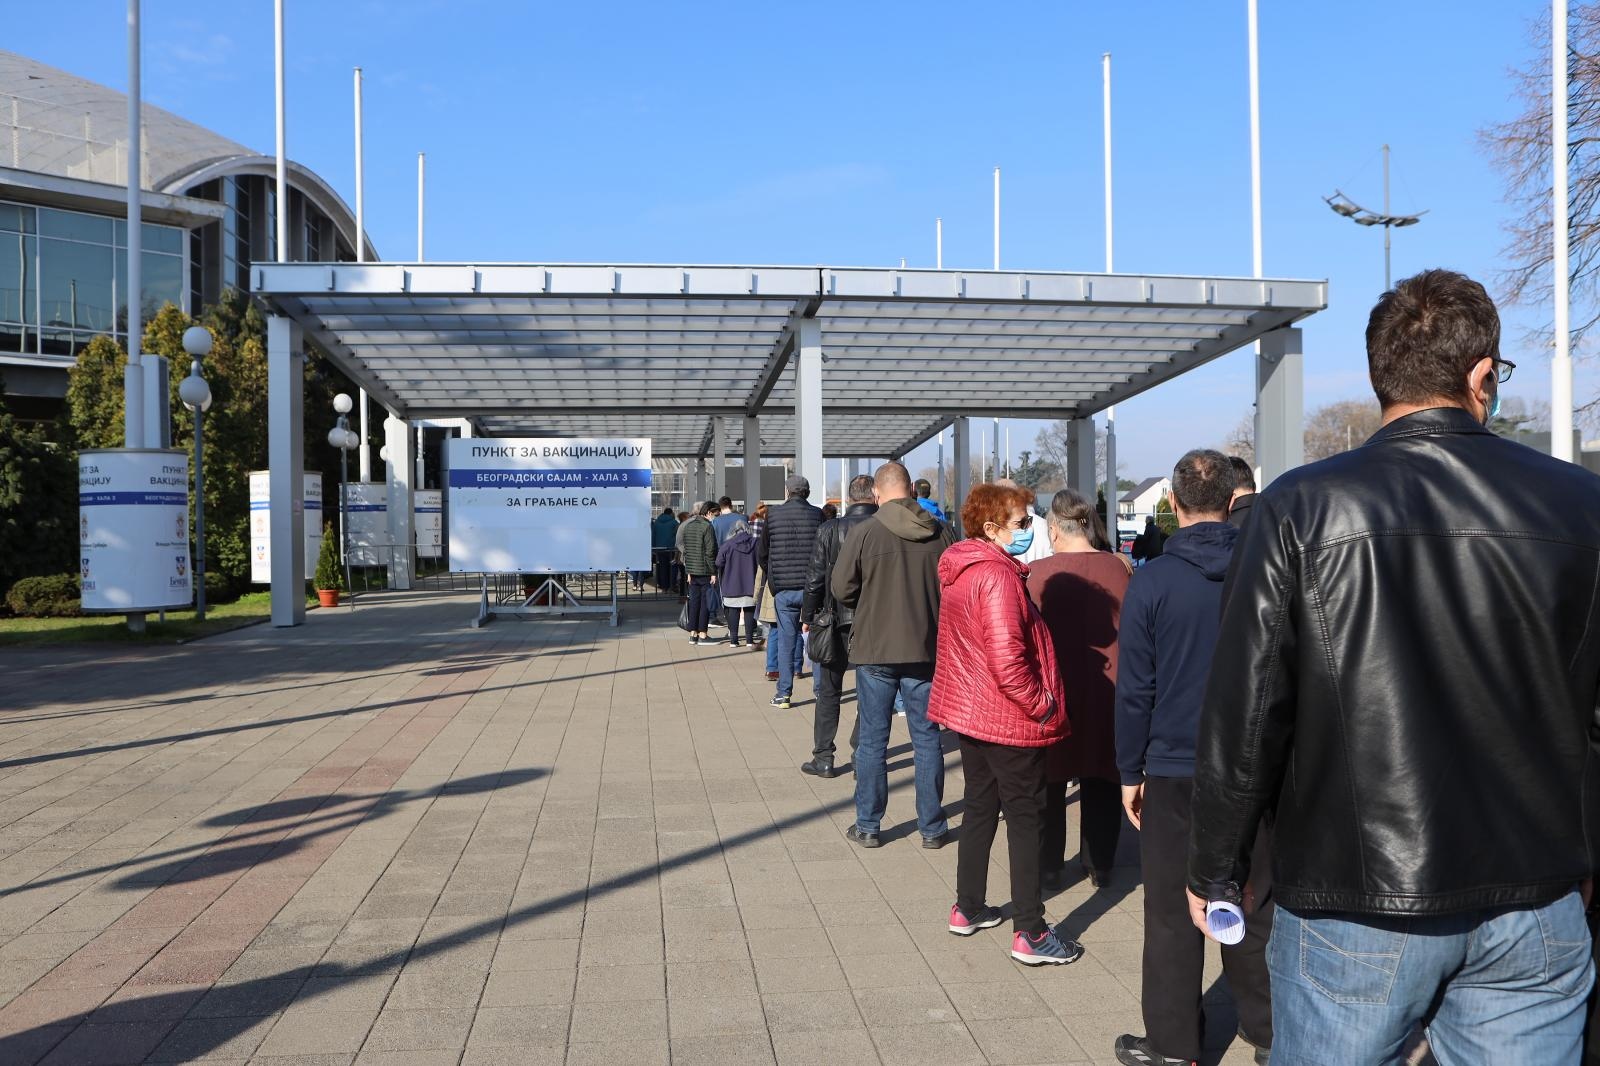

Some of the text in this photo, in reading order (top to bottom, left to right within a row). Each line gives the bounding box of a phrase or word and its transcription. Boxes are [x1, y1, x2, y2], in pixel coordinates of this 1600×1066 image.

[472, 446, 643, 459] ПУНКТ ЗА ВАКЦИНАЦИЈУ
[89, 466, 99, 474] ЗА
[476, 473, 544, 483] БЕОГРАДСКИ
[546, 473, 582, 482] САЈАМ
[592, 473, 619, 482] ХАЛА
[622, 473, 628, 482] 3
[506, 497, 597, 507] ЗА ГРАЂАНЕ СА
